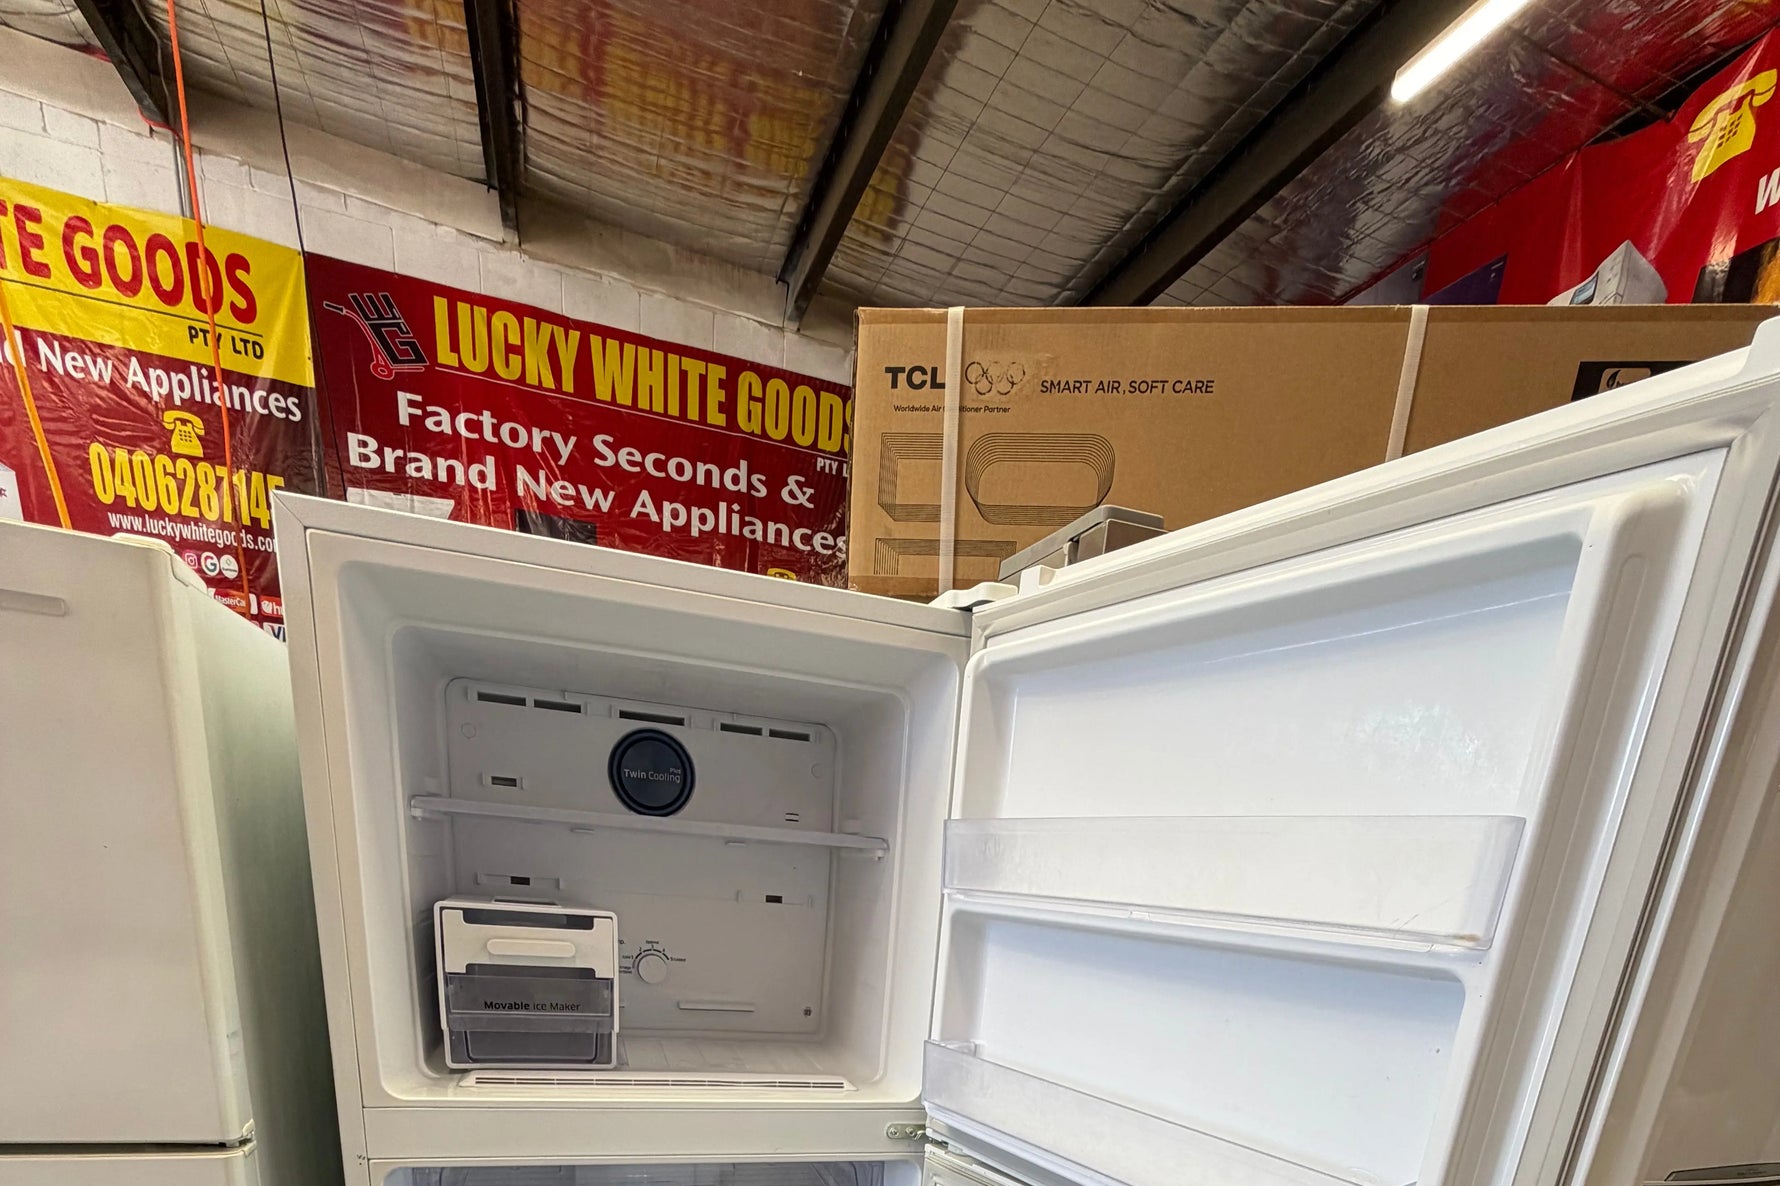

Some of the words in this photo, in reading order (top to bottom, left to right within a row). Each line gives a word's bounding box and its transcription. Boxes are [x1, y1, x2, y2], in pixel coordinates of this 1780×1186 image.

[62, 215, 257, 324] GOODS
[231, 335, 264, 360] LTD
[433, 295, 580, 393] LUCKY
[590, 334, 726, 427] WHITE
[37, 337, 112, 384] New
[126, 356, 302, 422] Appliances
[885, 366, 945, 390] TCL
[1040, 380, 1092, 394] SMART
[1172, 380, 1215, 394] CARE
[893, 404, 930, 413] Worldwide
[984, 405, 1011, 414] Partner
[397, 391, 577, 466] Factory
[592, 434, 767, 498] Seconds
[780, 475, 815, 509] &
[816, 457, 838, 475] PTY
[347, 432, 497, 491] Brand
[516, 464, 615, 512] New
[630, 490, 847, 560] Appliances
[624, 769, 646, 779] Twin
[648, 771, 681, 784] Cooling
[484, 1001, 530, 1011] Movable
[550, 1002, 580, 1012] Maker
